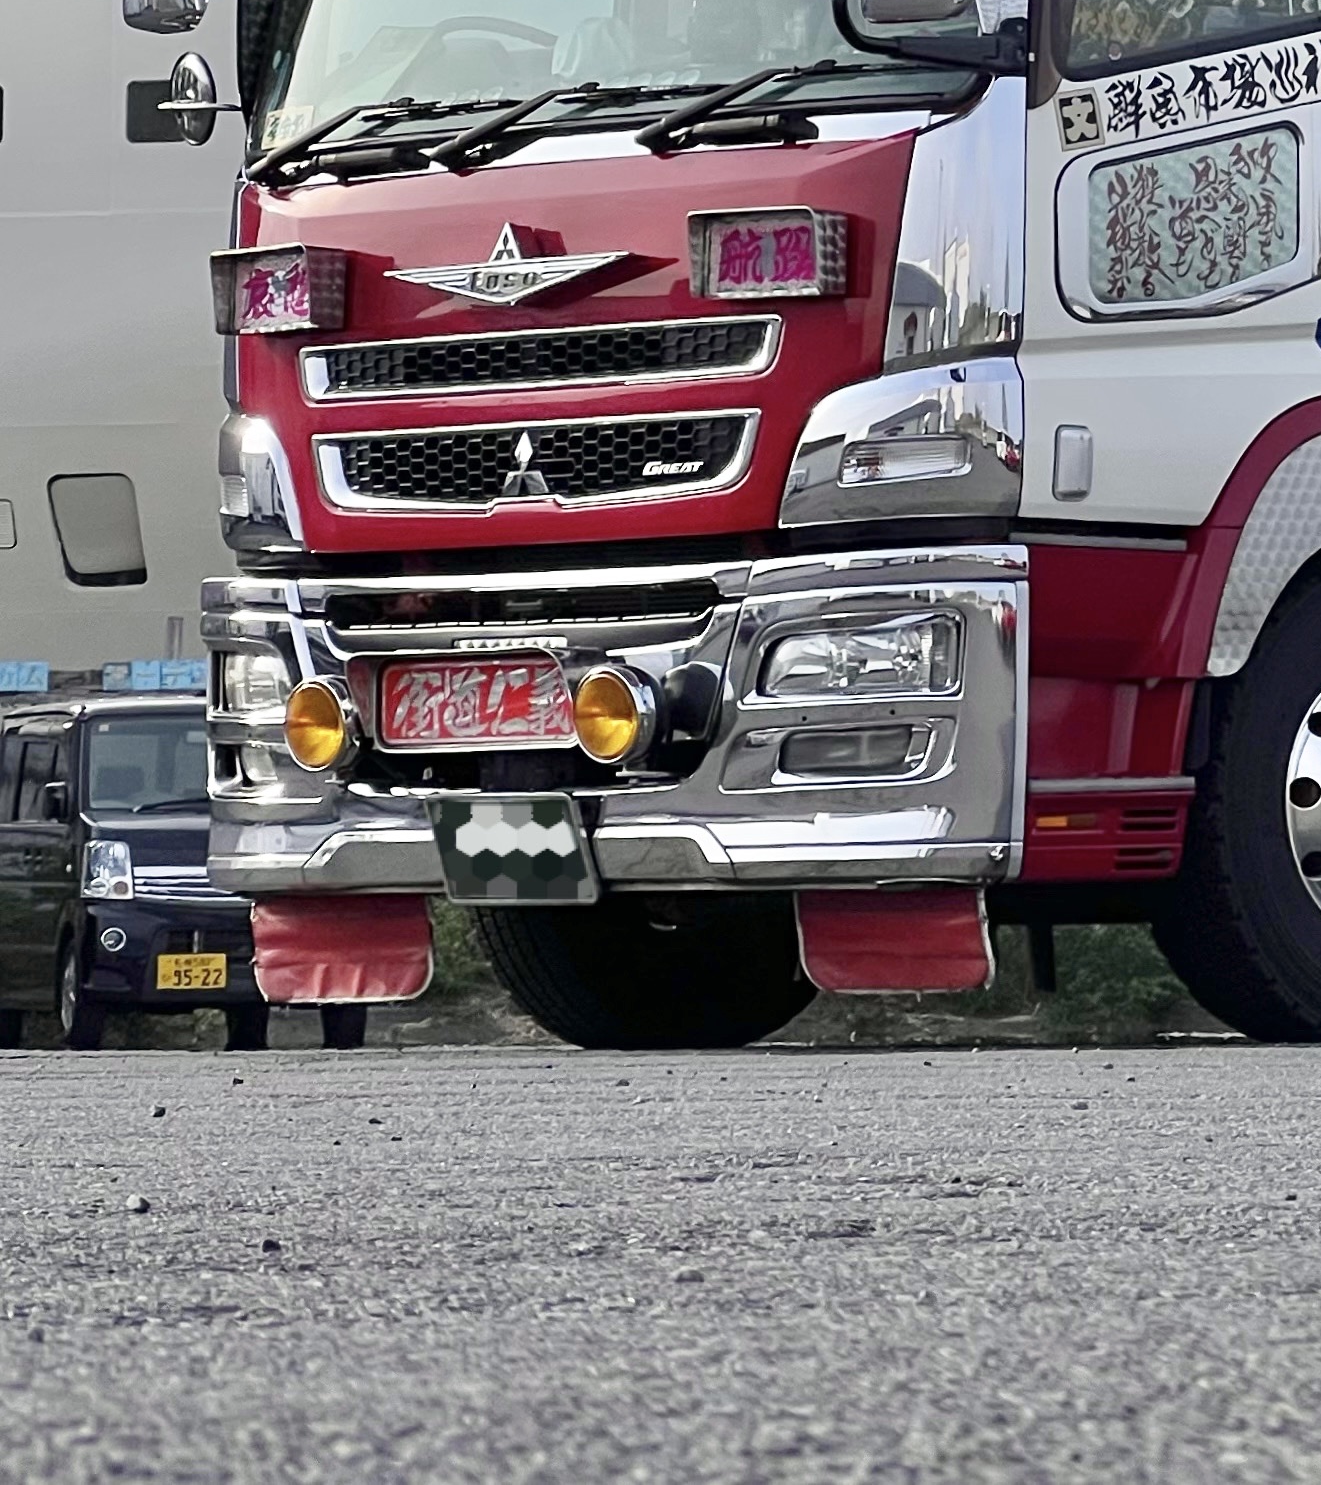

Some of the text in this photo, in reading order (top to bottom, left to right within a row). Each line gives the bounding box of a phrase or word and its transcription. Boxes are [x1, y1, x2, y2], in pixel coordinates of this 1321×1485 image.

[641, 460, 705, 476] GREAT
[391, 665, 573, 739] 街道仁義
[172, 967, 223, 987] 95-22
